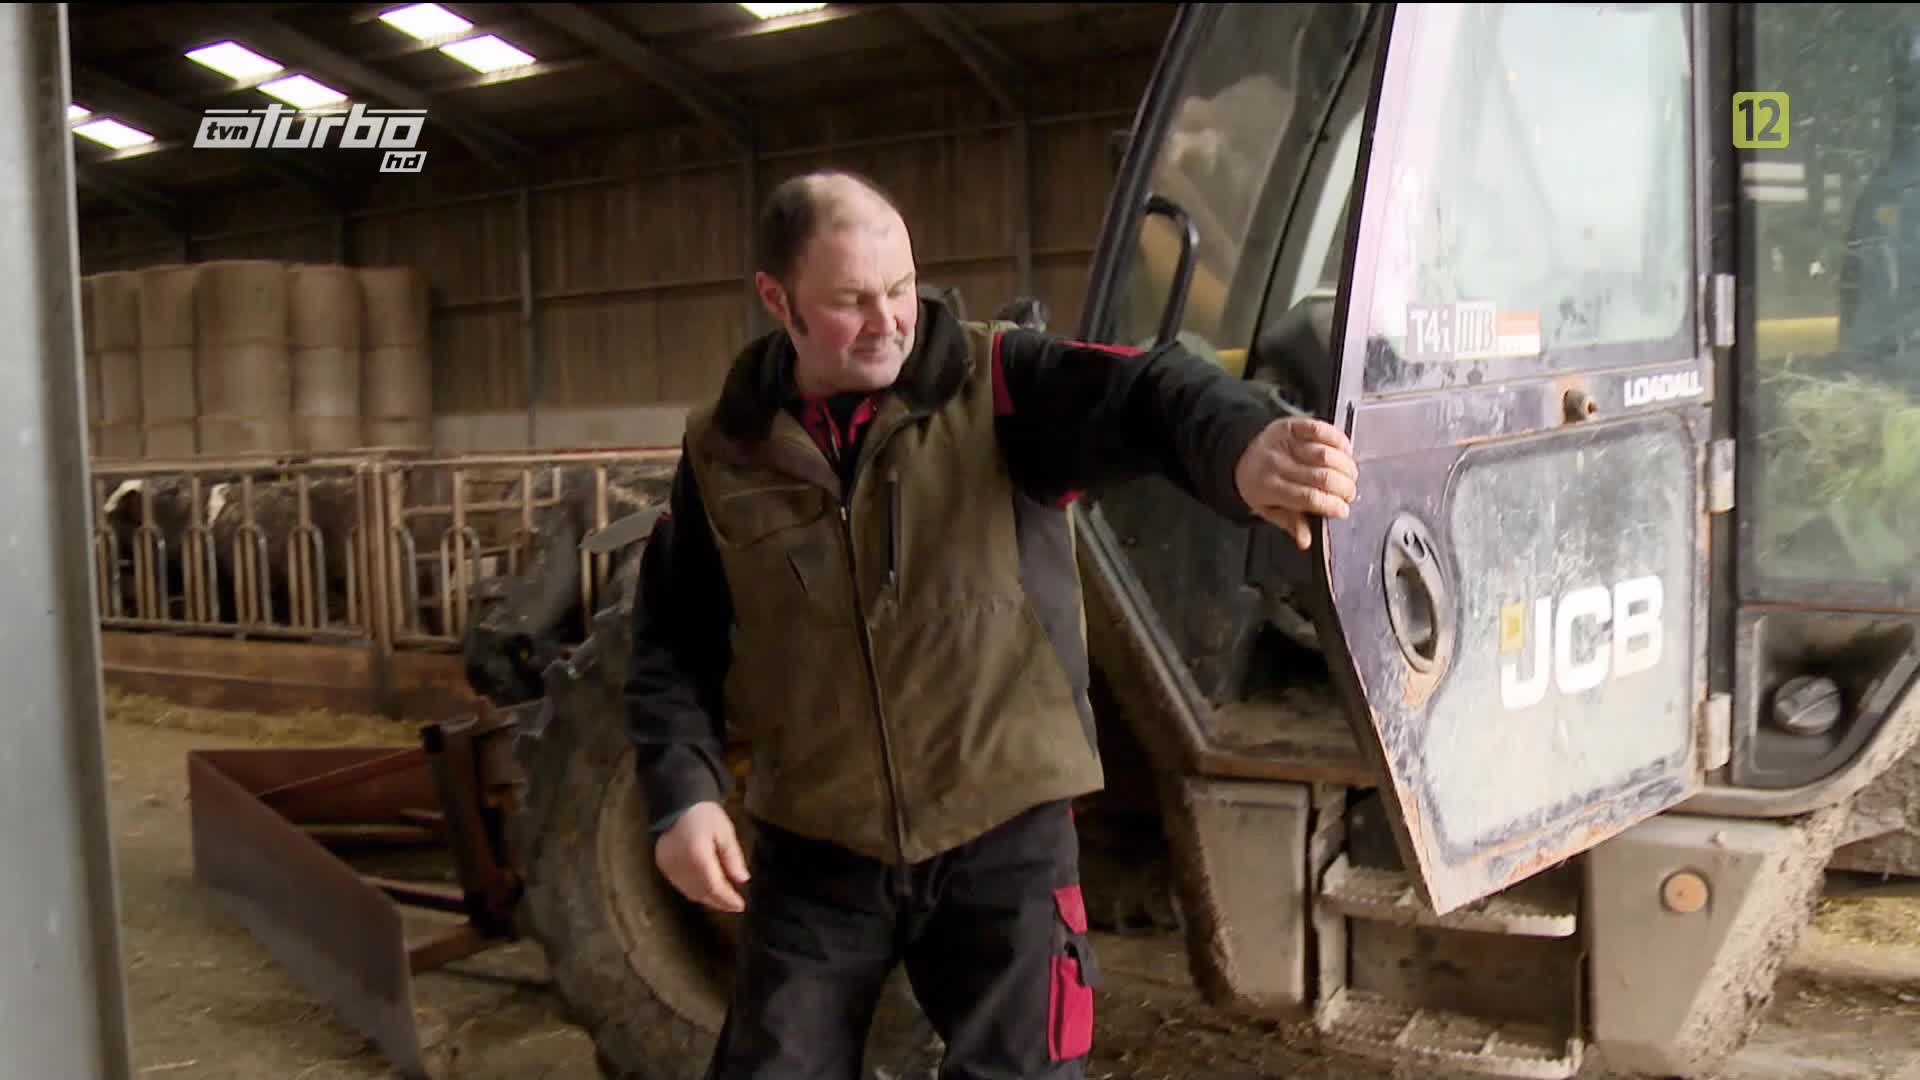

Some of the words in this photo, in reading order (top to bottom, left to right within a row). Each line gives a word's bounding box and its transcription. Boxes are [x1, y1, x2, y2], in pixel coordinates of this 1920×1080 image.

[1409, 309, 1450, 352] T4i
[1624, 371, 1704, 406] LOADALL
[1501, 575, 1664, 711] JCB
